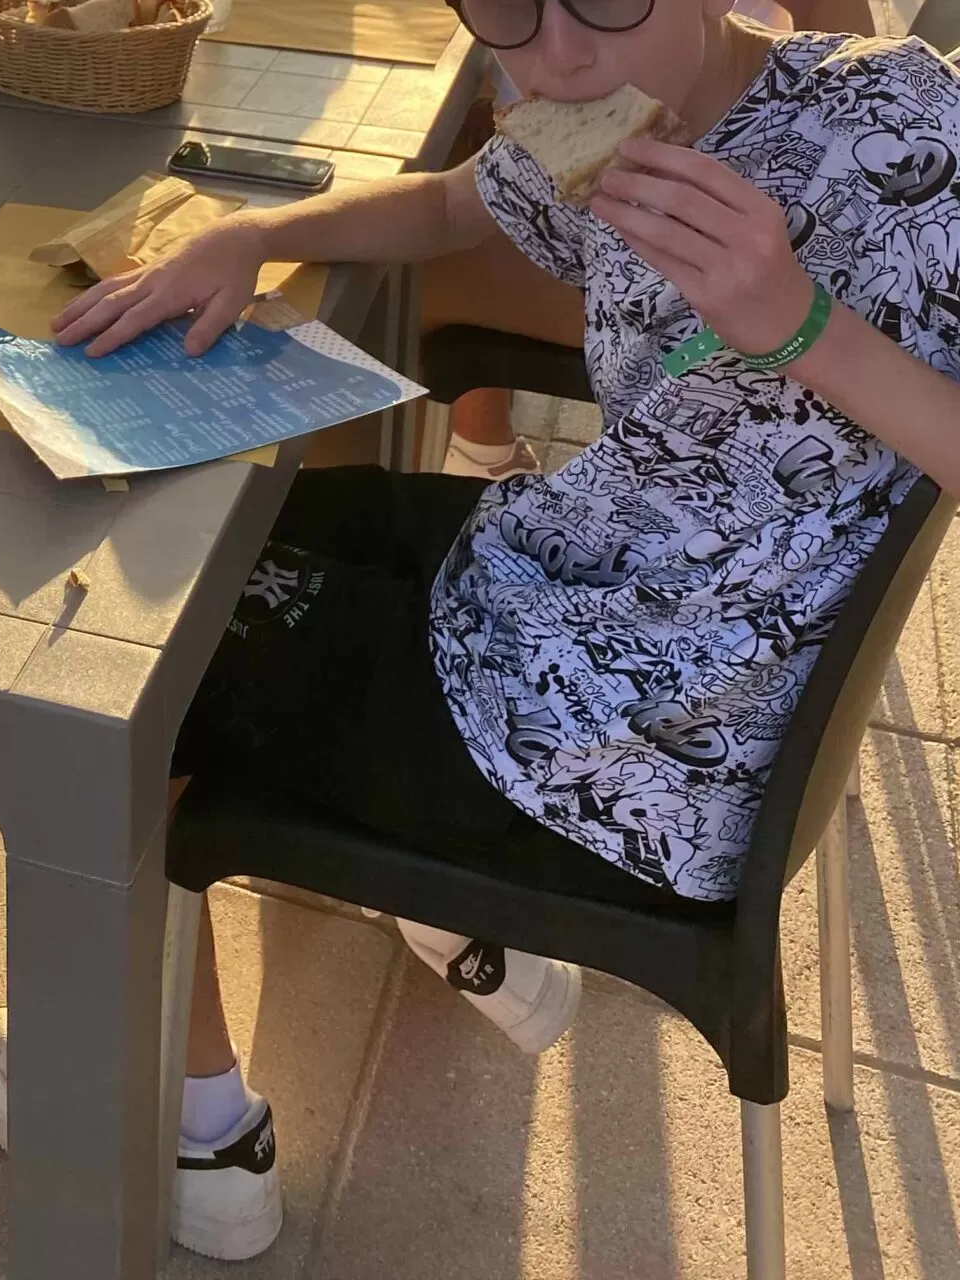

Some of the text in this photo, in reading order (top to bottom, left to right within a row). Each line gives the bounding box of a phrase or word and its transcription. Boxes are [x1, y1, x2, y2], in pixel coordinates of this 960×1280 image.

[775, 336, 805, 362] LUNGA
[282, 600, 310, 628] THE
[472, 963, 495, 987] AIR
